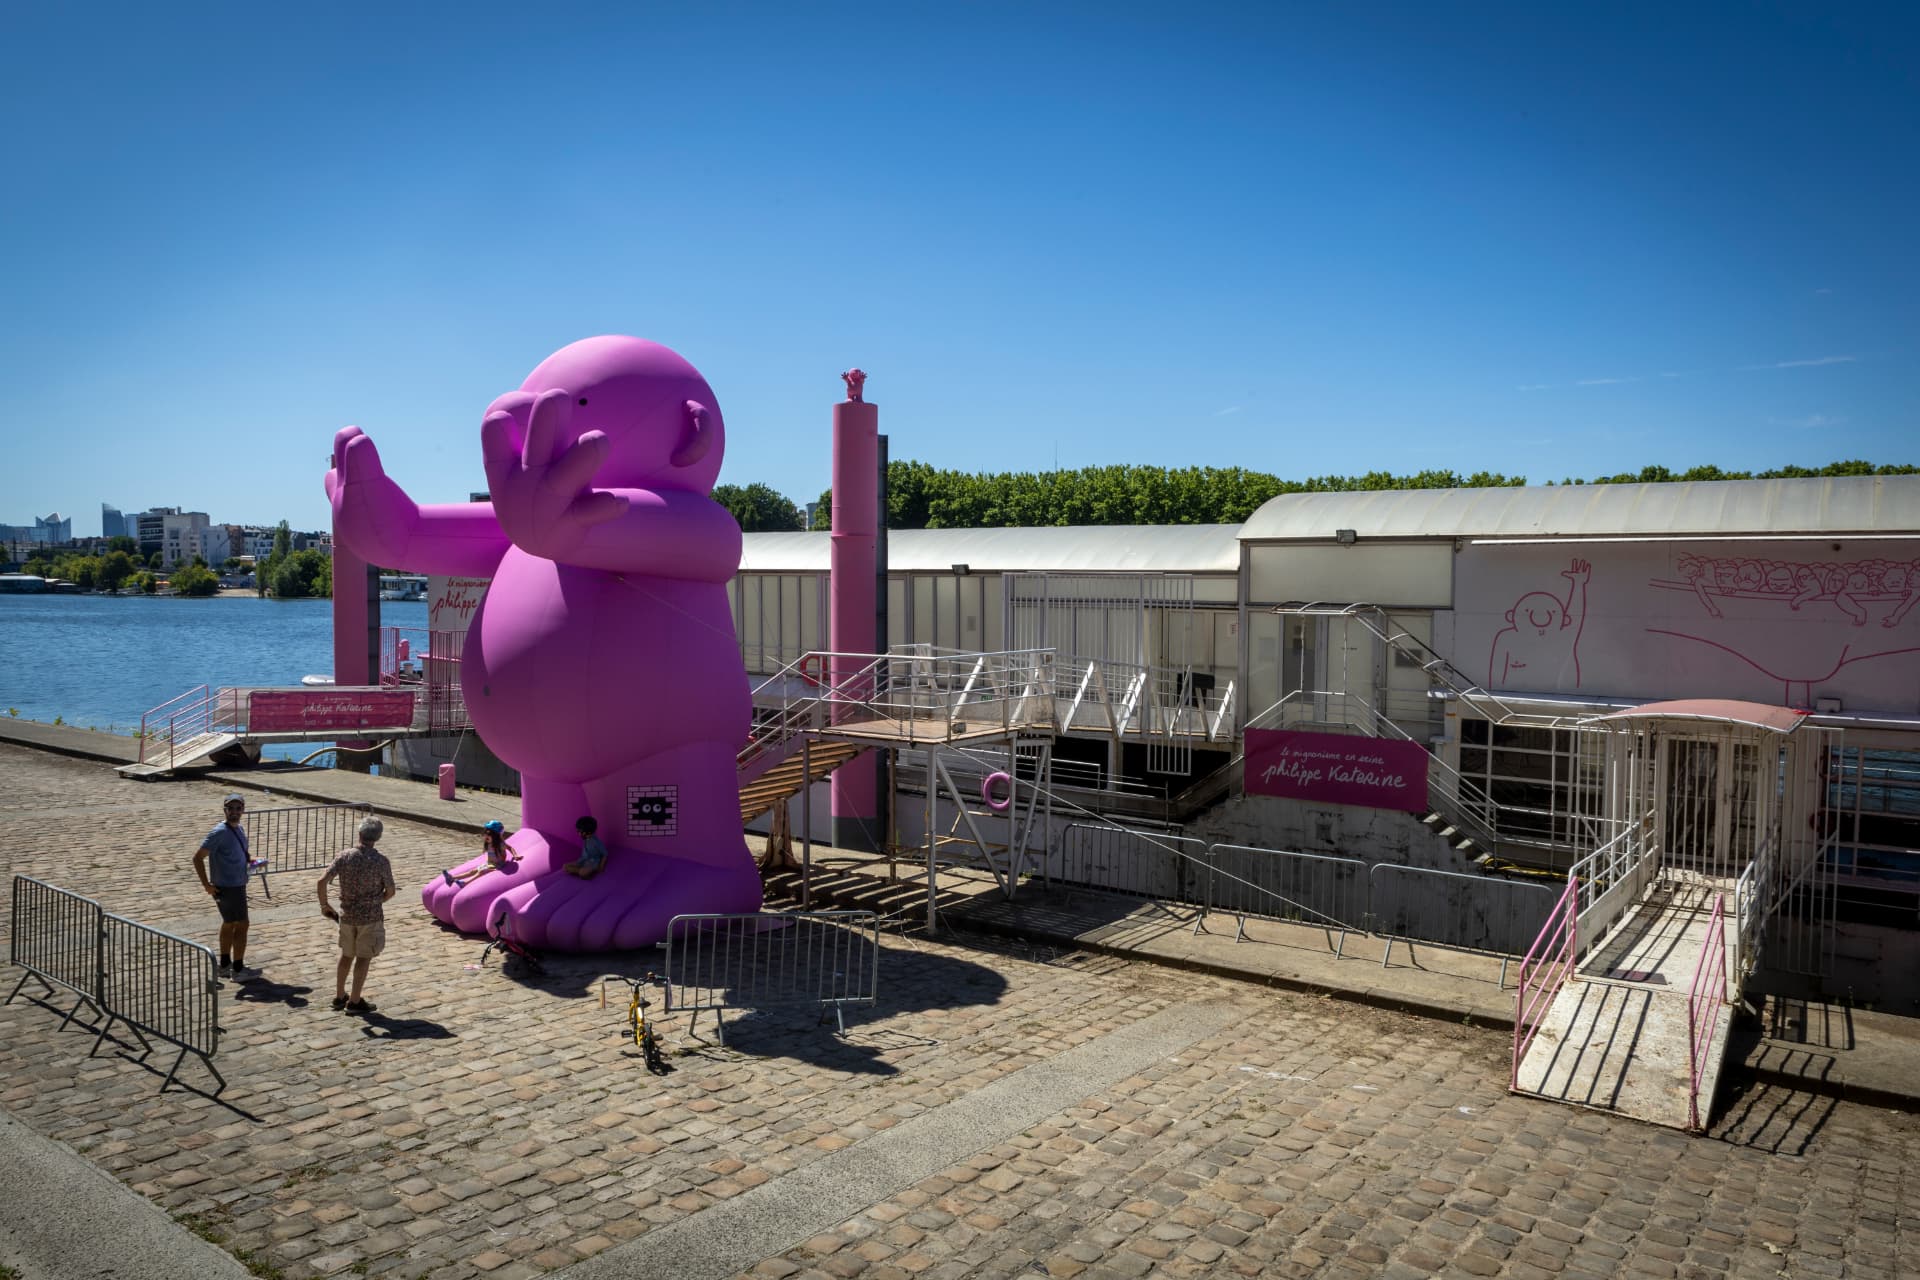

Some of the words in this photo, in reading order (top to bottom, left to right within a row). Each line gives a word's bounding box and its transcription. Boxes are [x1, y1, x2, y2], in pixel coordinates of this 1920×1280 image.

[431, 590, 478, 623] philippe
[300, 702, 333, 717] philippe
[1280, 746, 1290, 757] le
[1293, 750, 1341, 763] mignonisme
[1344, 753, 1356, 761] en
[1357, 755, 1385, 765] seine
[1261, 759, 1322, 787] philippe
[1328, 765, 1407, 788] Katerine
